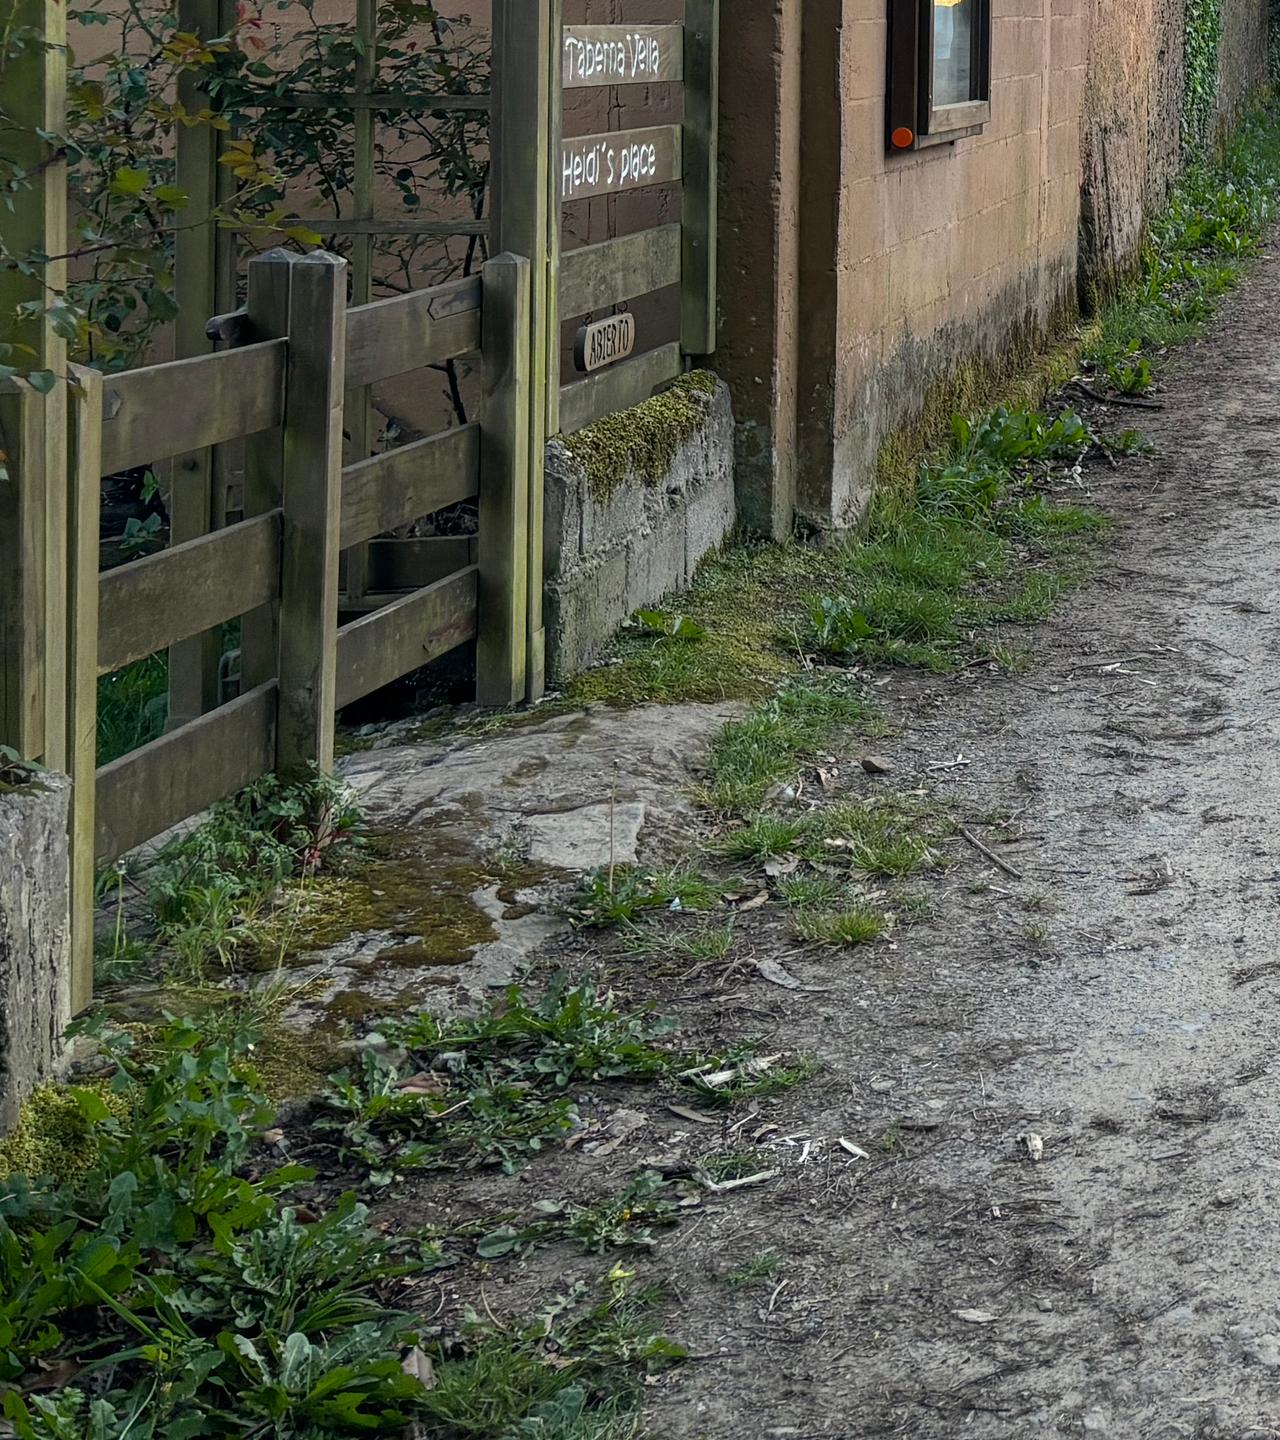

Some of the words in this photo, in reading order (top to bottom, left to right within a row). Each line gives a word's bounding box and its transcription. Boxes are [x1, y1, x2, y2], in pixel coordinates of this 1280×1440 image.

[565, 35, 625, 81] Taberna
[625, 33, 660, 79] Vella
[619, 143, 656, 186] place
[588, 319, 630, 367] ABIERTO
